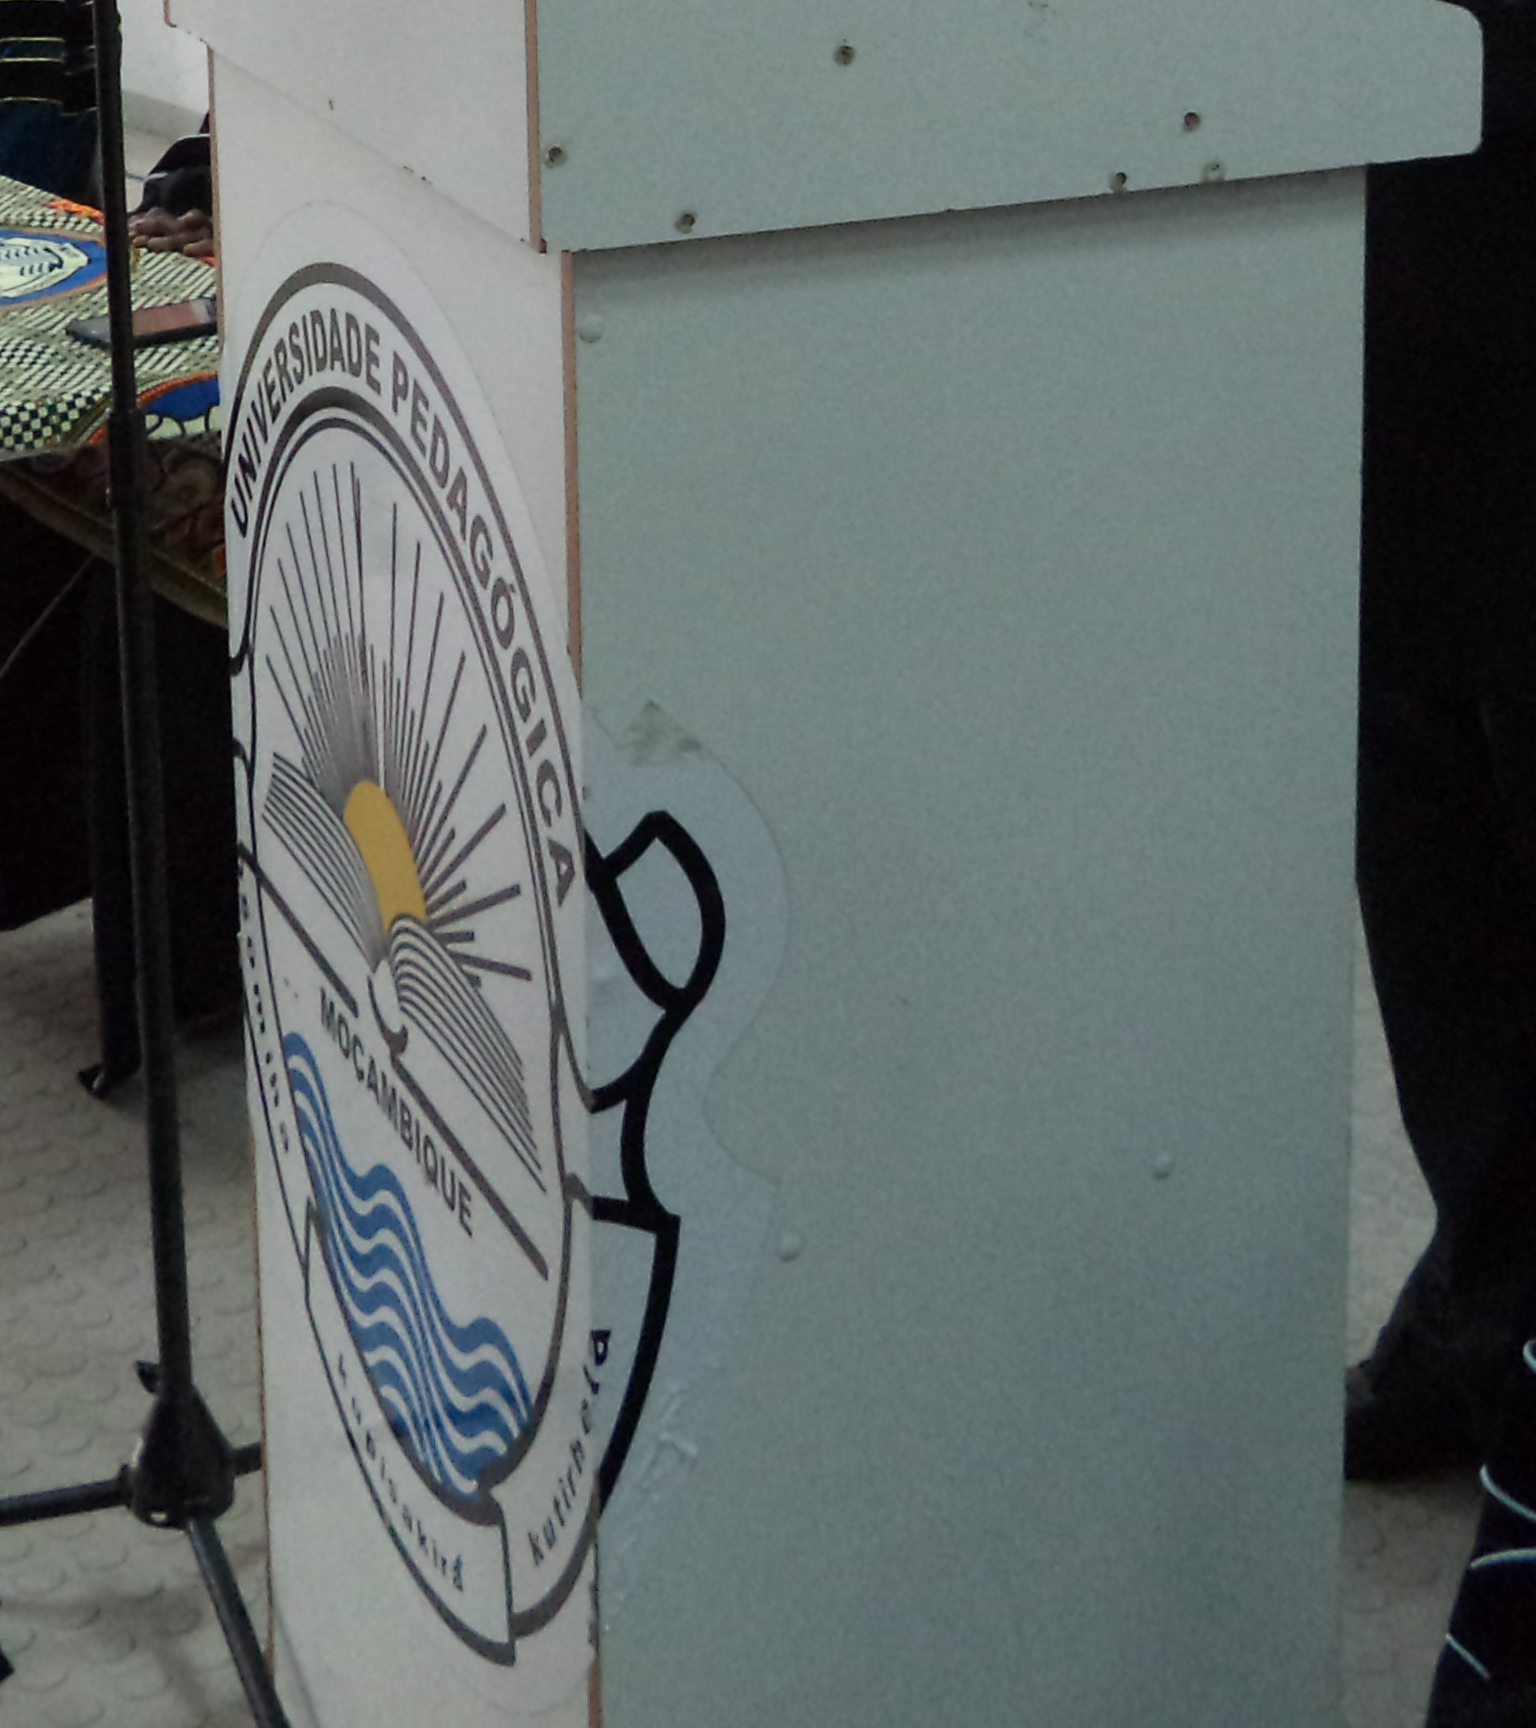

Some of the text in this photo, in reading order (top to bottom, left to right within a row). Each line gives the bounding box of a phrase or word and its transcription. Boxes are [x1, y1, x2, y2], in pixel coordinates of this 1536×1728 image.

[231, 307, 577, 908] UNIVERSIDADE PEDAGÓGICA
[320, 984, 474, 1240] MOÇAMBIQUE
